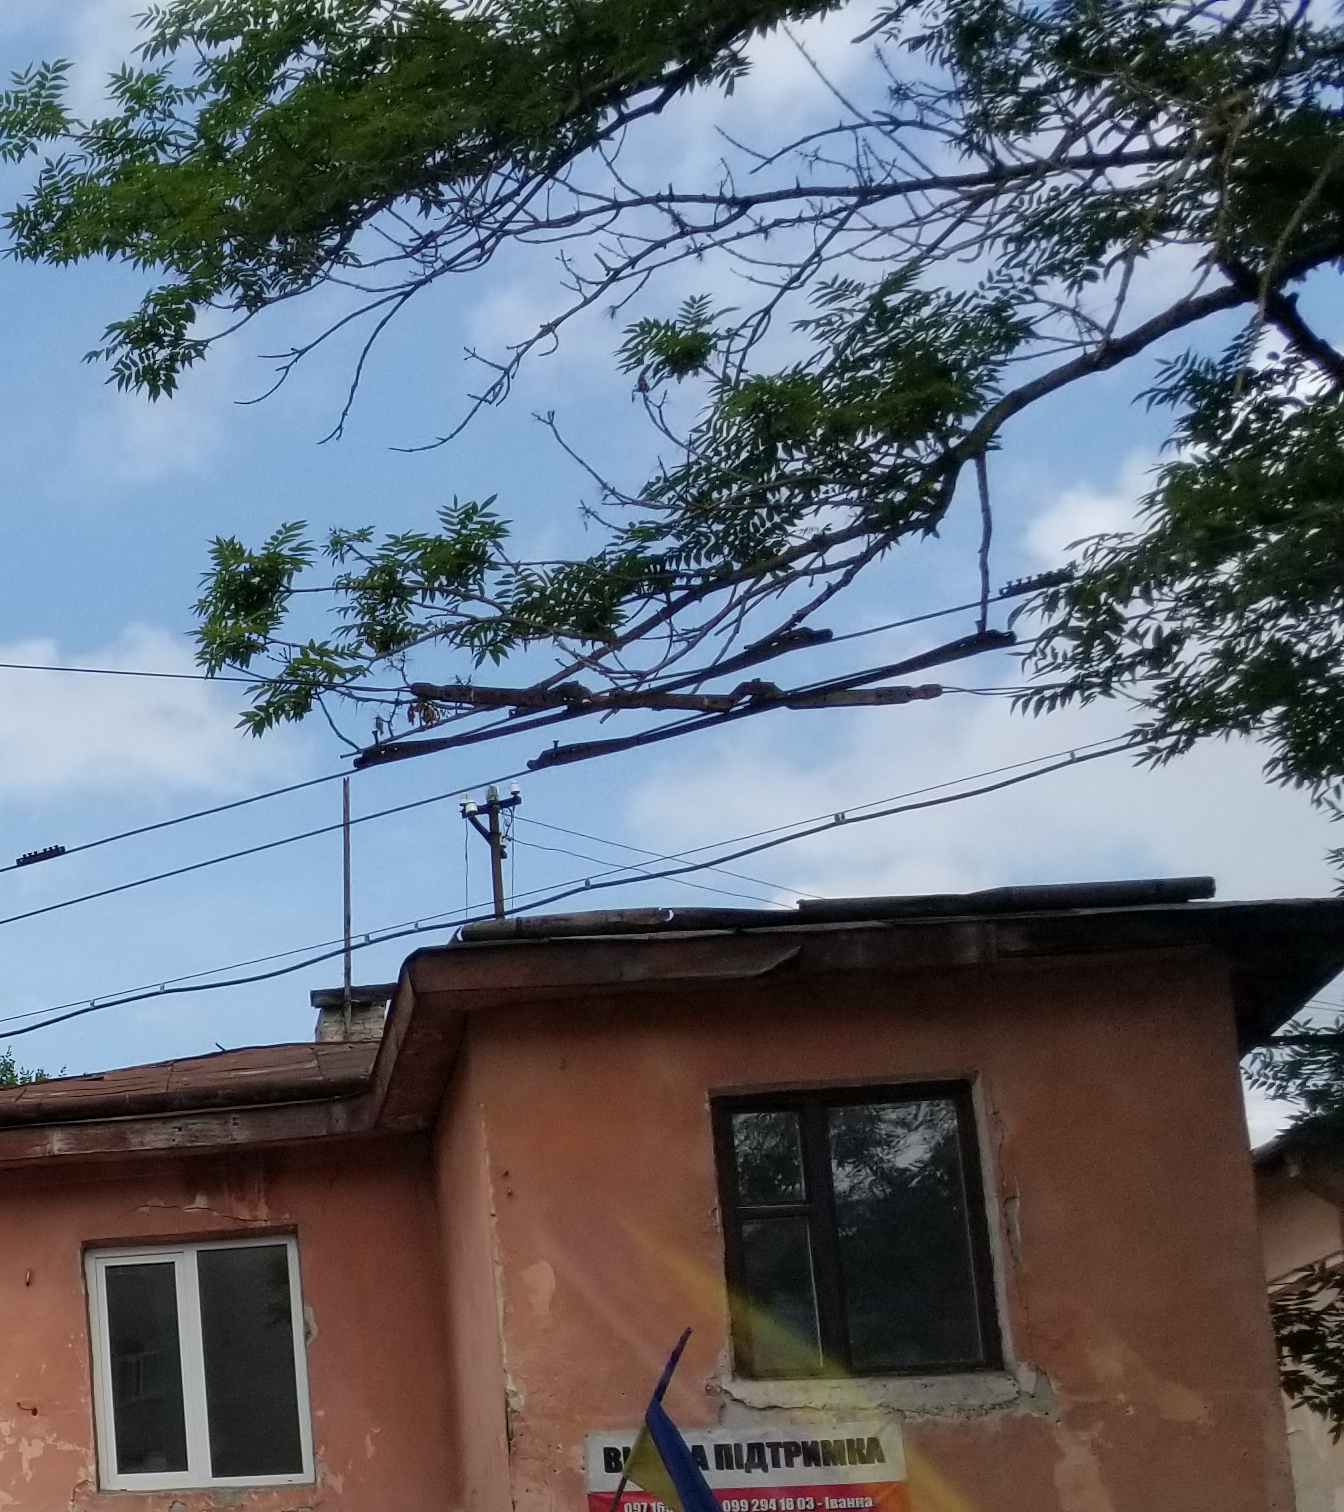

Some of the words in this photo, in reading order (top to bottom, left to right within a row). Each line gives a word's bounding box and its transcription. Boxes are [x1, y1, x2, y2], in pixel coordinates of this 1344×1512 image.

[714, 1437, 886, 1473] ПІДТРИМКА
[722, 1500, 748, 1512] 099
[751, 1499, 777, 1512] 294
[779, 1498, 794, 1511] 18
[796, 1497, 815, 1511] 03
